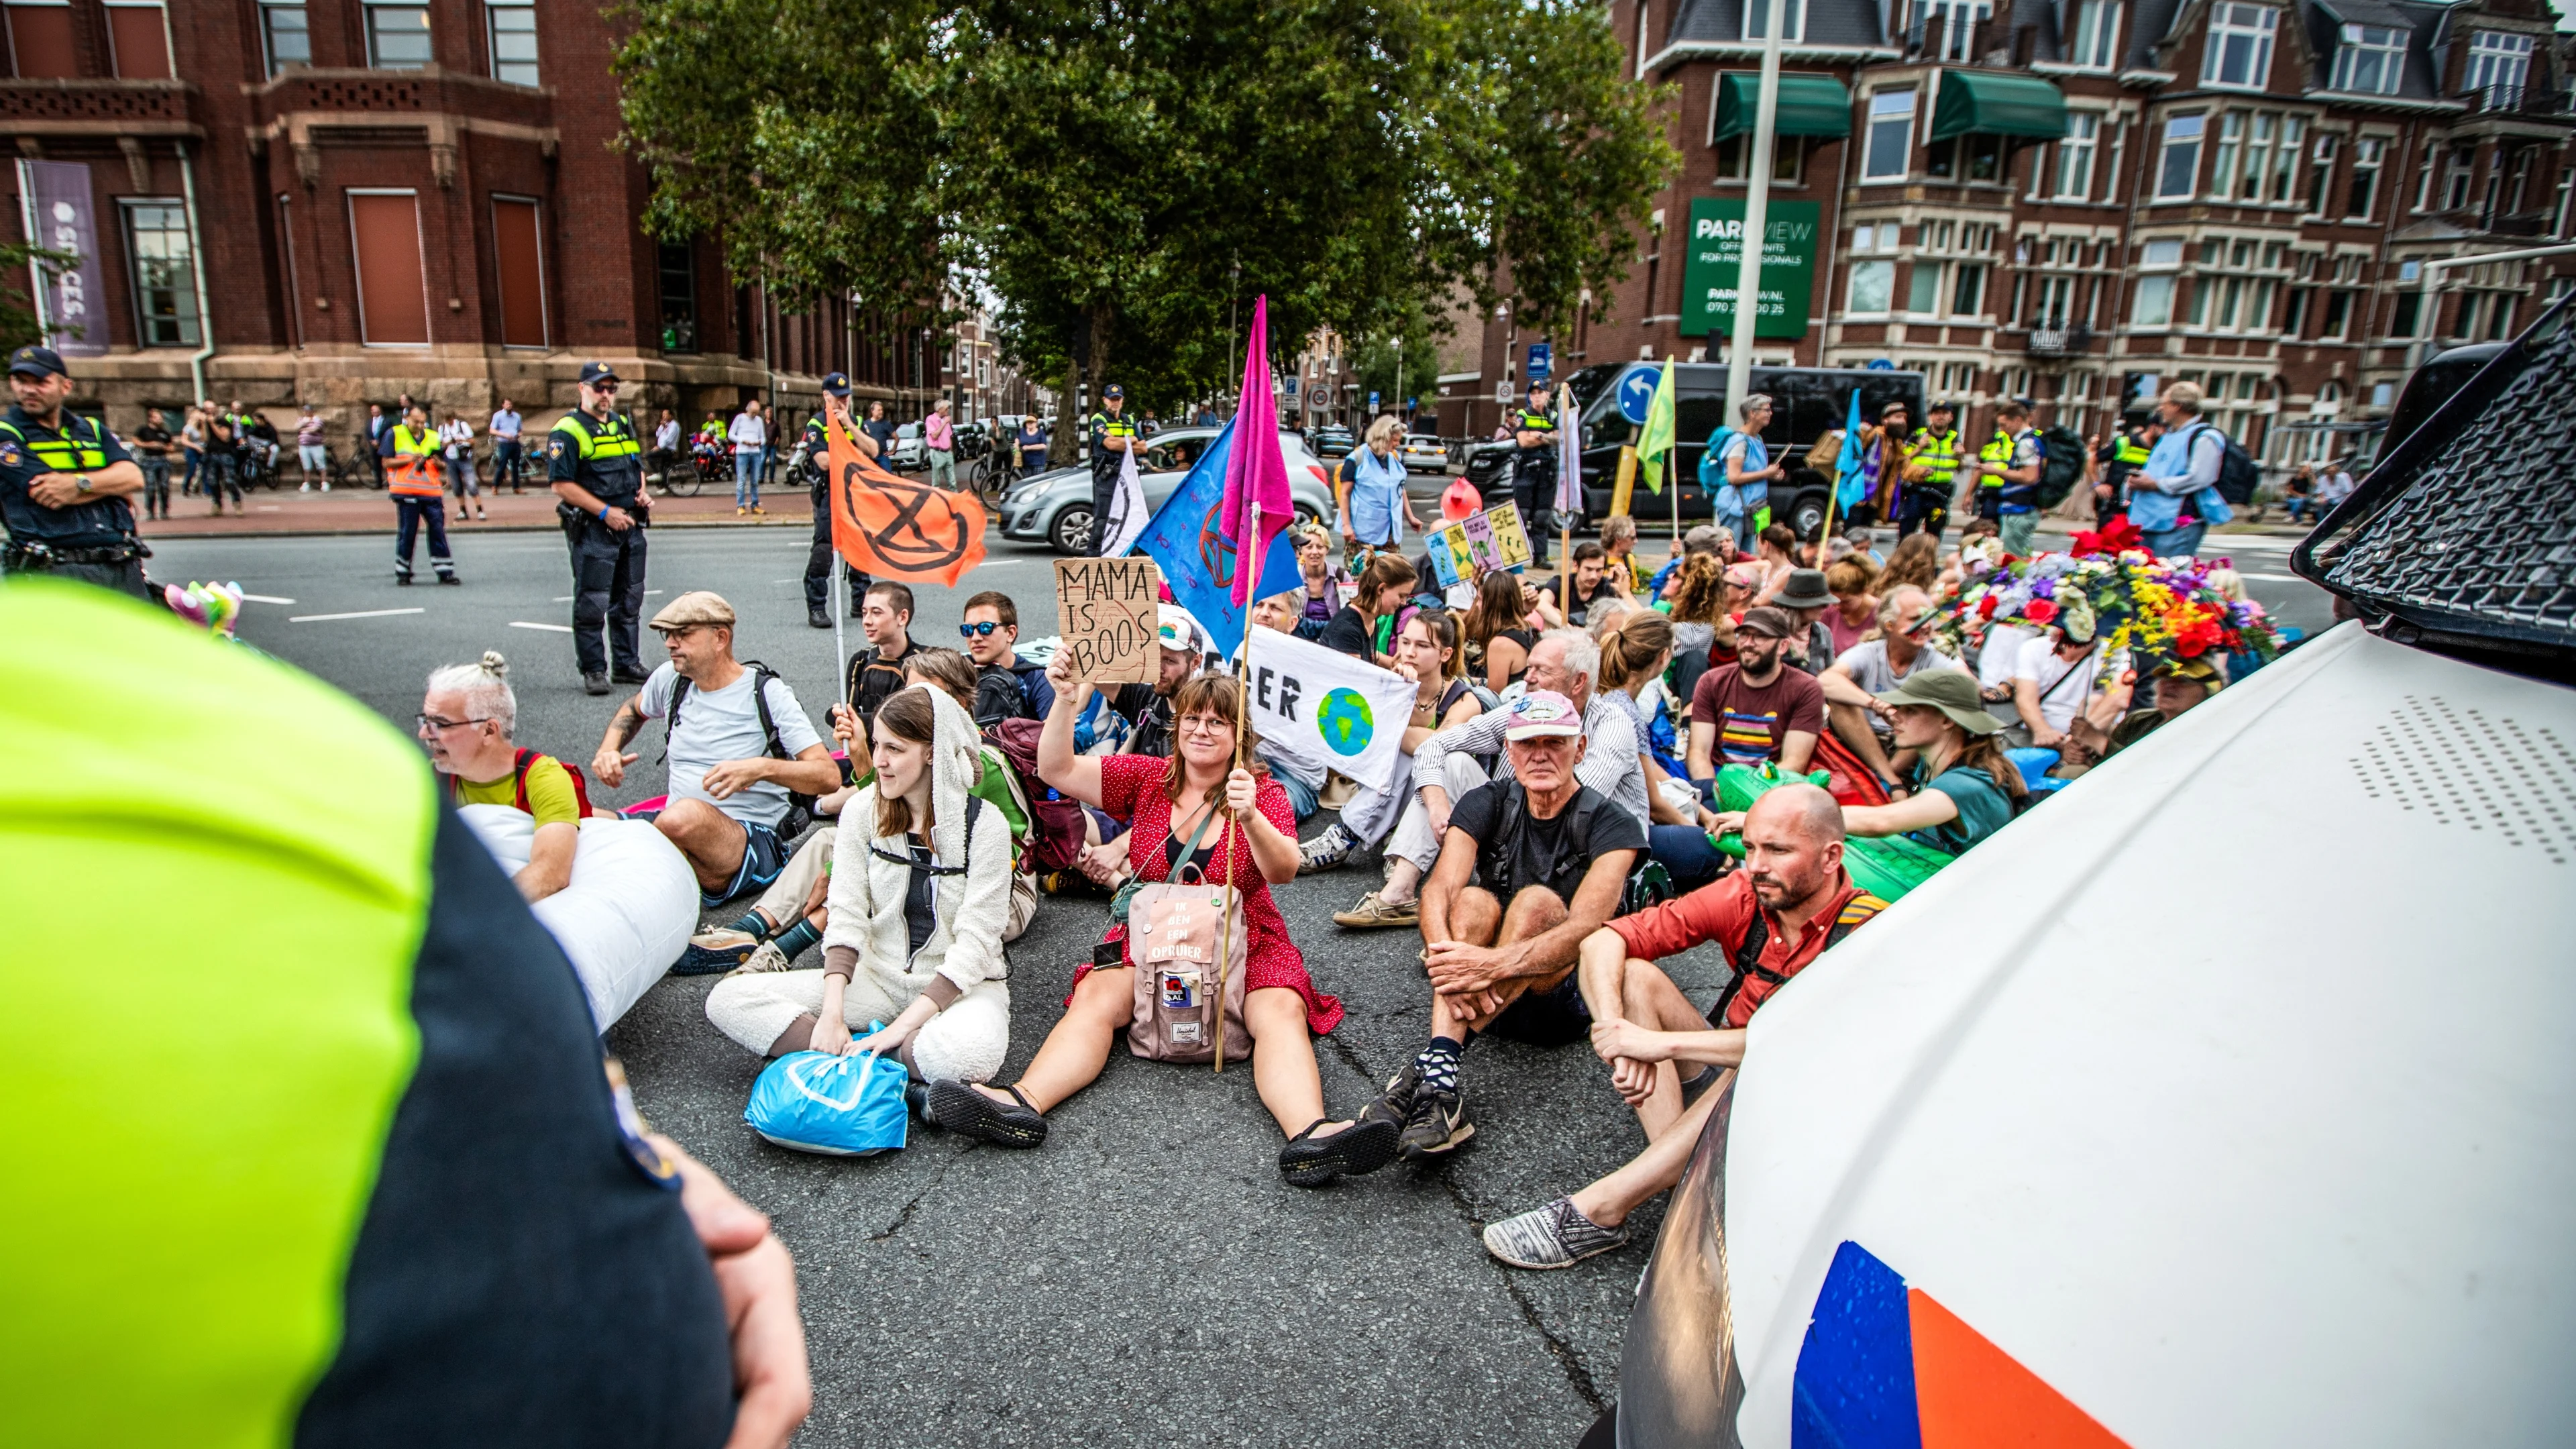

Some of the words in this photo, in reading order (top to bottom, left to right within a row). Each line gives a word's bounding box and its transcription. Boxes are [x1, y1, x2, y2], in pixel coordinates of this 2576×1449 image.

[1697, 219, 1811, 241] PARVIEW
[1699, 252, 1723, 264] FOR
[1723, 252, 1803, 267] PROSIONALS
[55, 225, 86, 320] SPCES.
[1707, 288, 1786, 303] PARKW.NL
[1705, 301, 1729, 314] 070
[1770, 303, 1785, 317] 25
[1061, 561, 1150, 602] MAMA
[1067, 603, 1095, 633] IS
[1073, 610, 1151, 678] BOOS
[1521, 701, 1563, 715] ANCUN
[1175, 902, 1188, 912] IK
[1168, 915, 1191, 926] BEN
[1167, 929, 1188, 940] EEN
[1151, 945, 1201, 959] OPRUIER
[1165, 979, 1183, 991] 10
